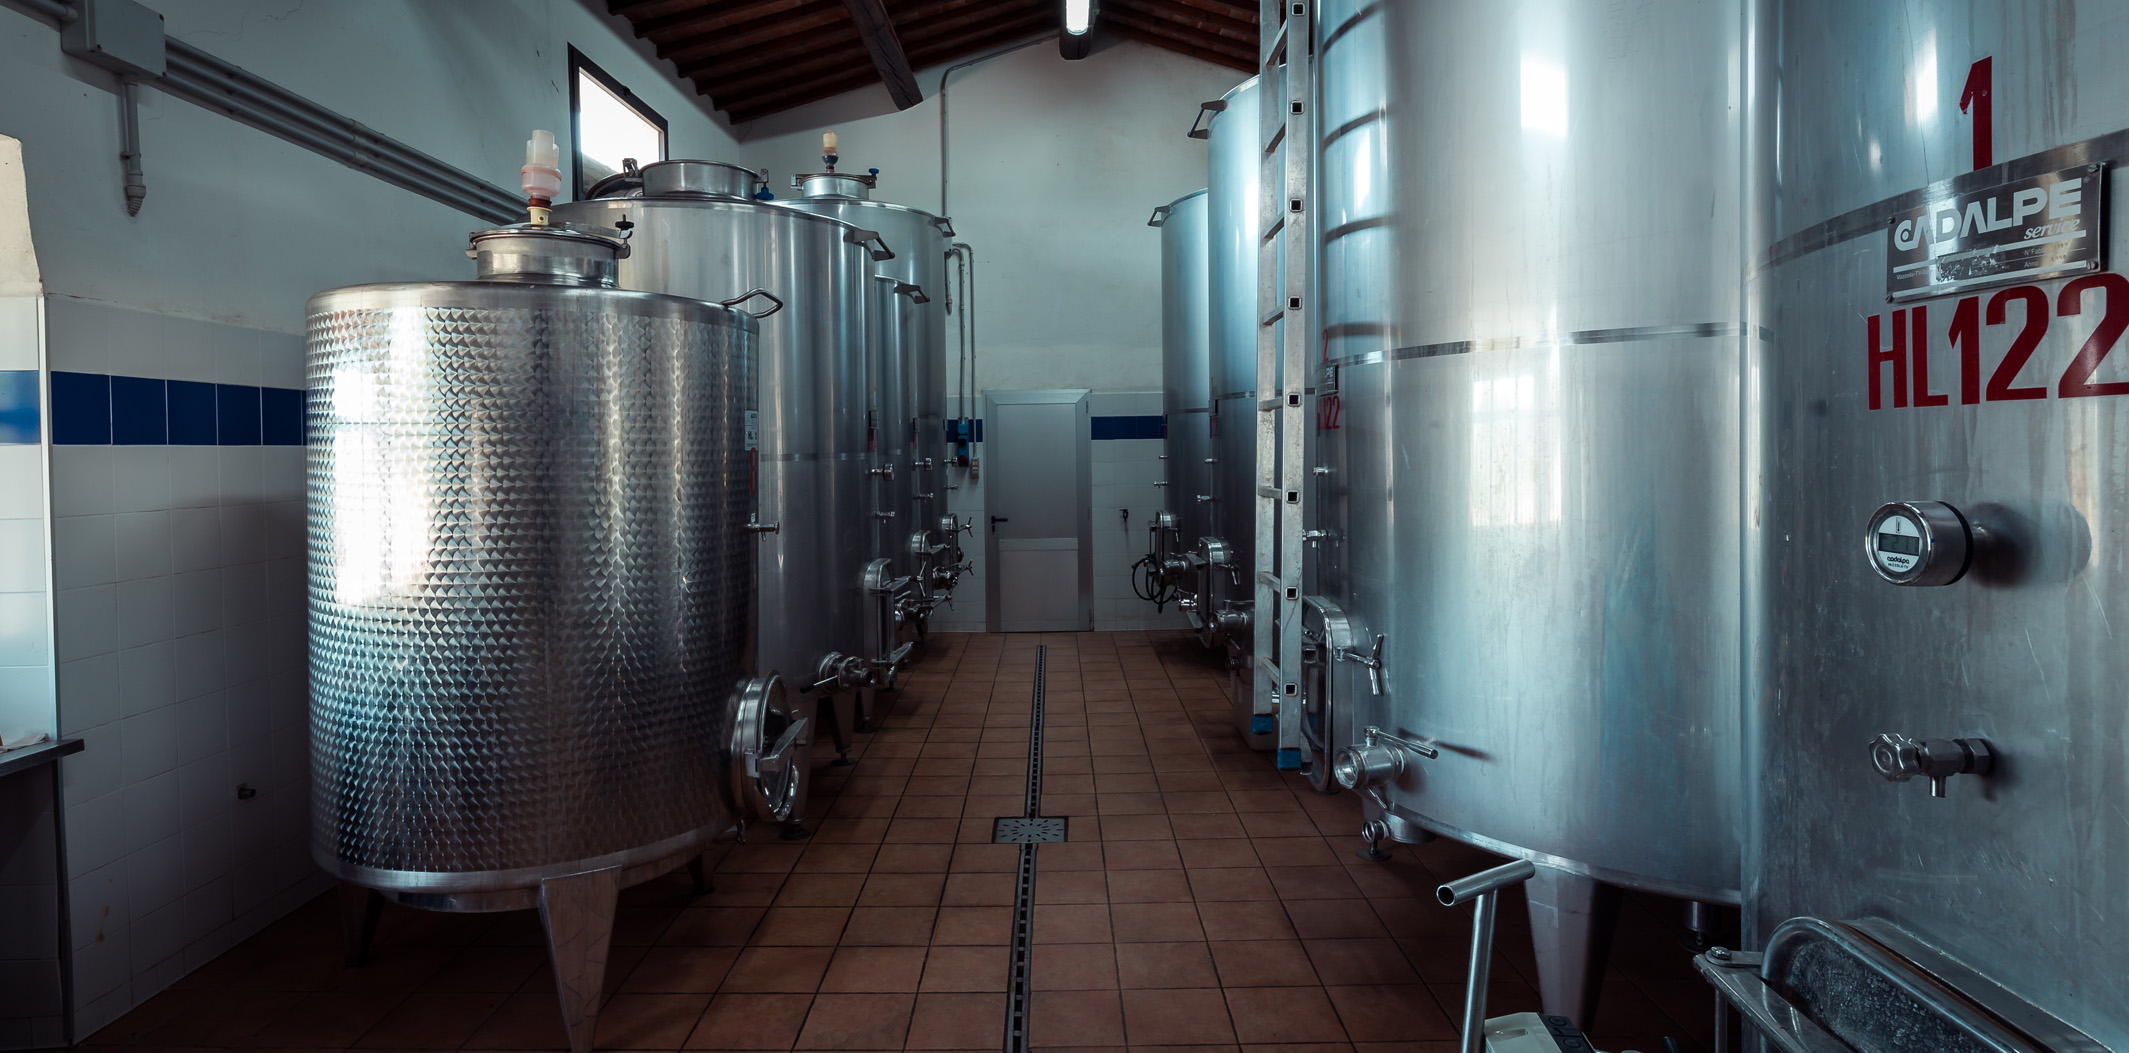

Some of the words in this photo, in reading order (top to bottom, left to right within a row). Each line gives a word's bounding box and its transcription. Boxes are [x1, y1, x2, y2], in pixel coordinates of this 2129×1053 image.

[1959, 55, 1993, 171] 1
[1894, 178, 2082, 251] CADALPE
[2023, 217, 2081, 240] service
[1322, 329, 1329, 362] 2
[1867, 273, 2129, 411] HL122
